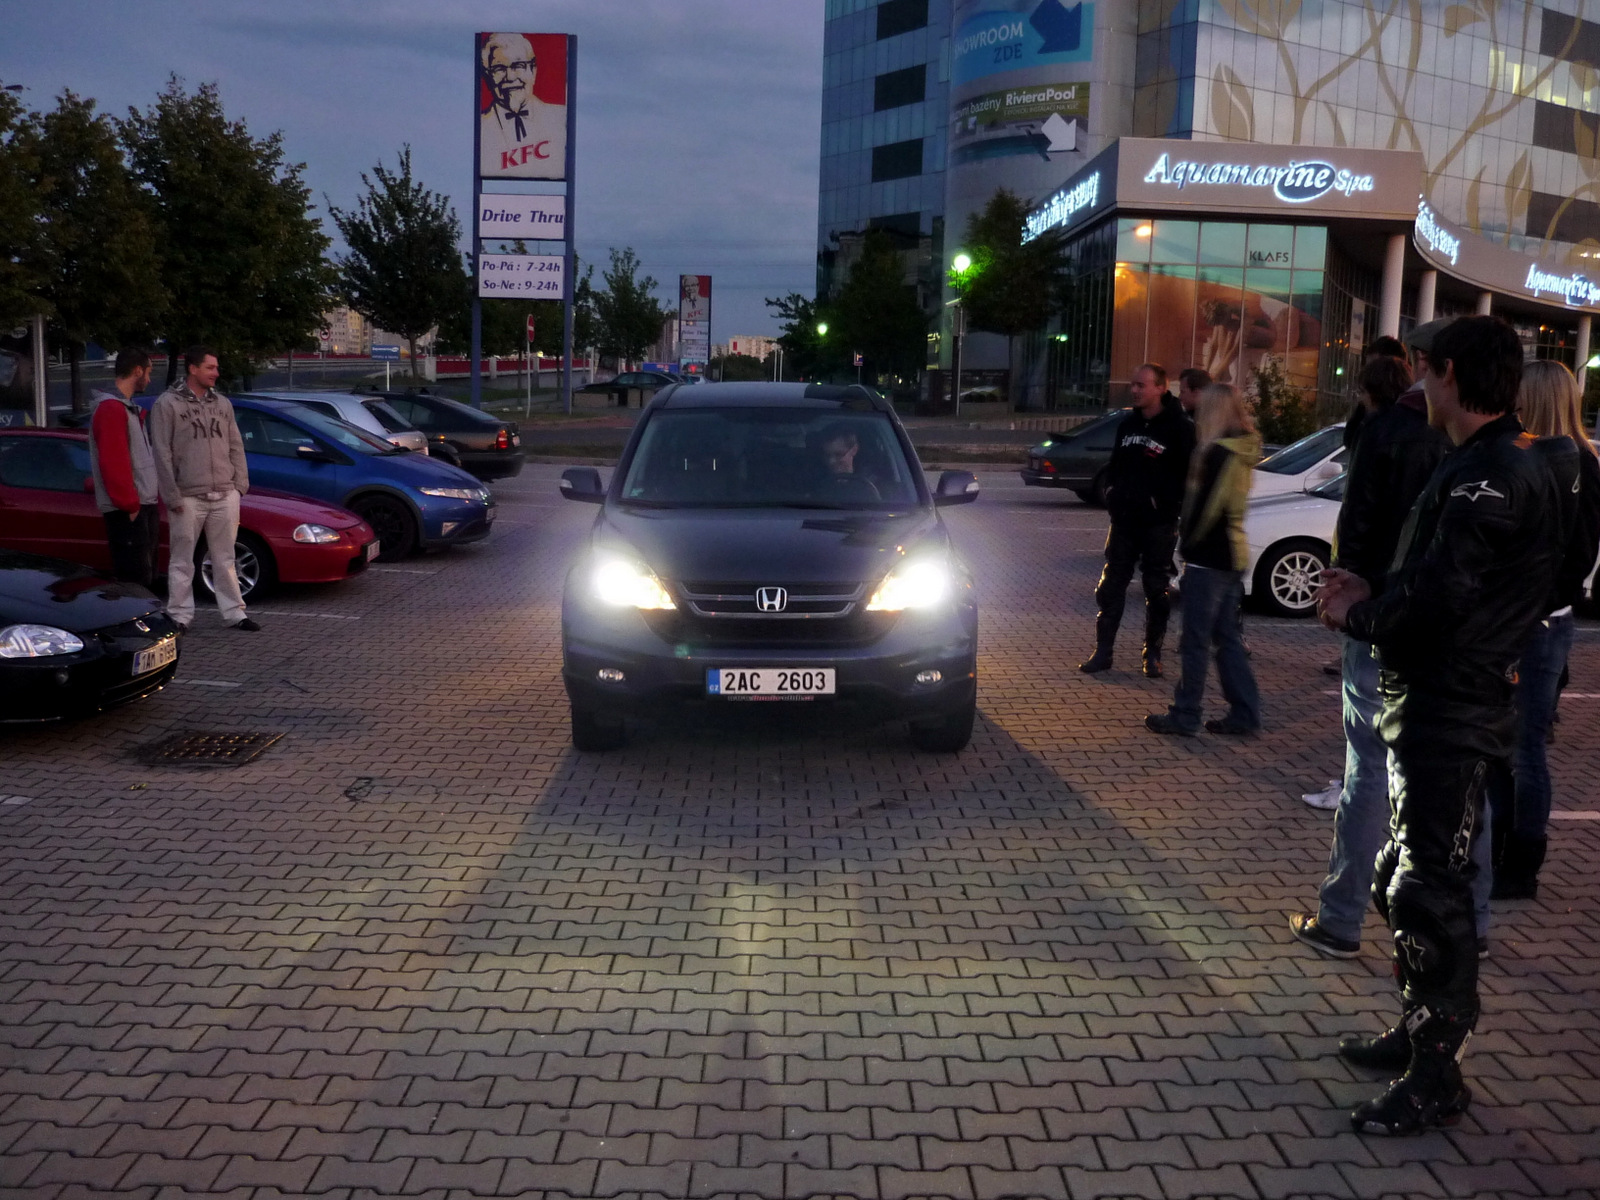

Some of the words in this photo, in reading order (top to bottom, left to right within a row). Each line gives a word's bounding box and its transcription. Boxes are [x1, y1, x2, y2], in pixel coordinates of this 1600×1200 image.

[993, 42, 1023, 64] ZDE
[970, 98, 1002, 114] bazény
[1005, 85, 1076, 106] RivieraPool
[501, 140, 550, 170] KFC
[1143, 152, 1330, 192] Aquamarine
[1334, 168, 1375, 198] Spa
[481, 209, 521, 223] Drive
[530, 210, 564, 224] Thru
[1249, 250, 1289, 263] KLAFS
[526, 261, 561, 273] 7-24h
[525, 280, 559, 291] 9-24h
[1524, 263, 1589, 299] Aquamarine
[687, 309, 703, 318] KFC
[180, 407, 201, 421] NEW
[725, 672, 761, 691] 2AC
[777, 672, 826, 691] 2603
